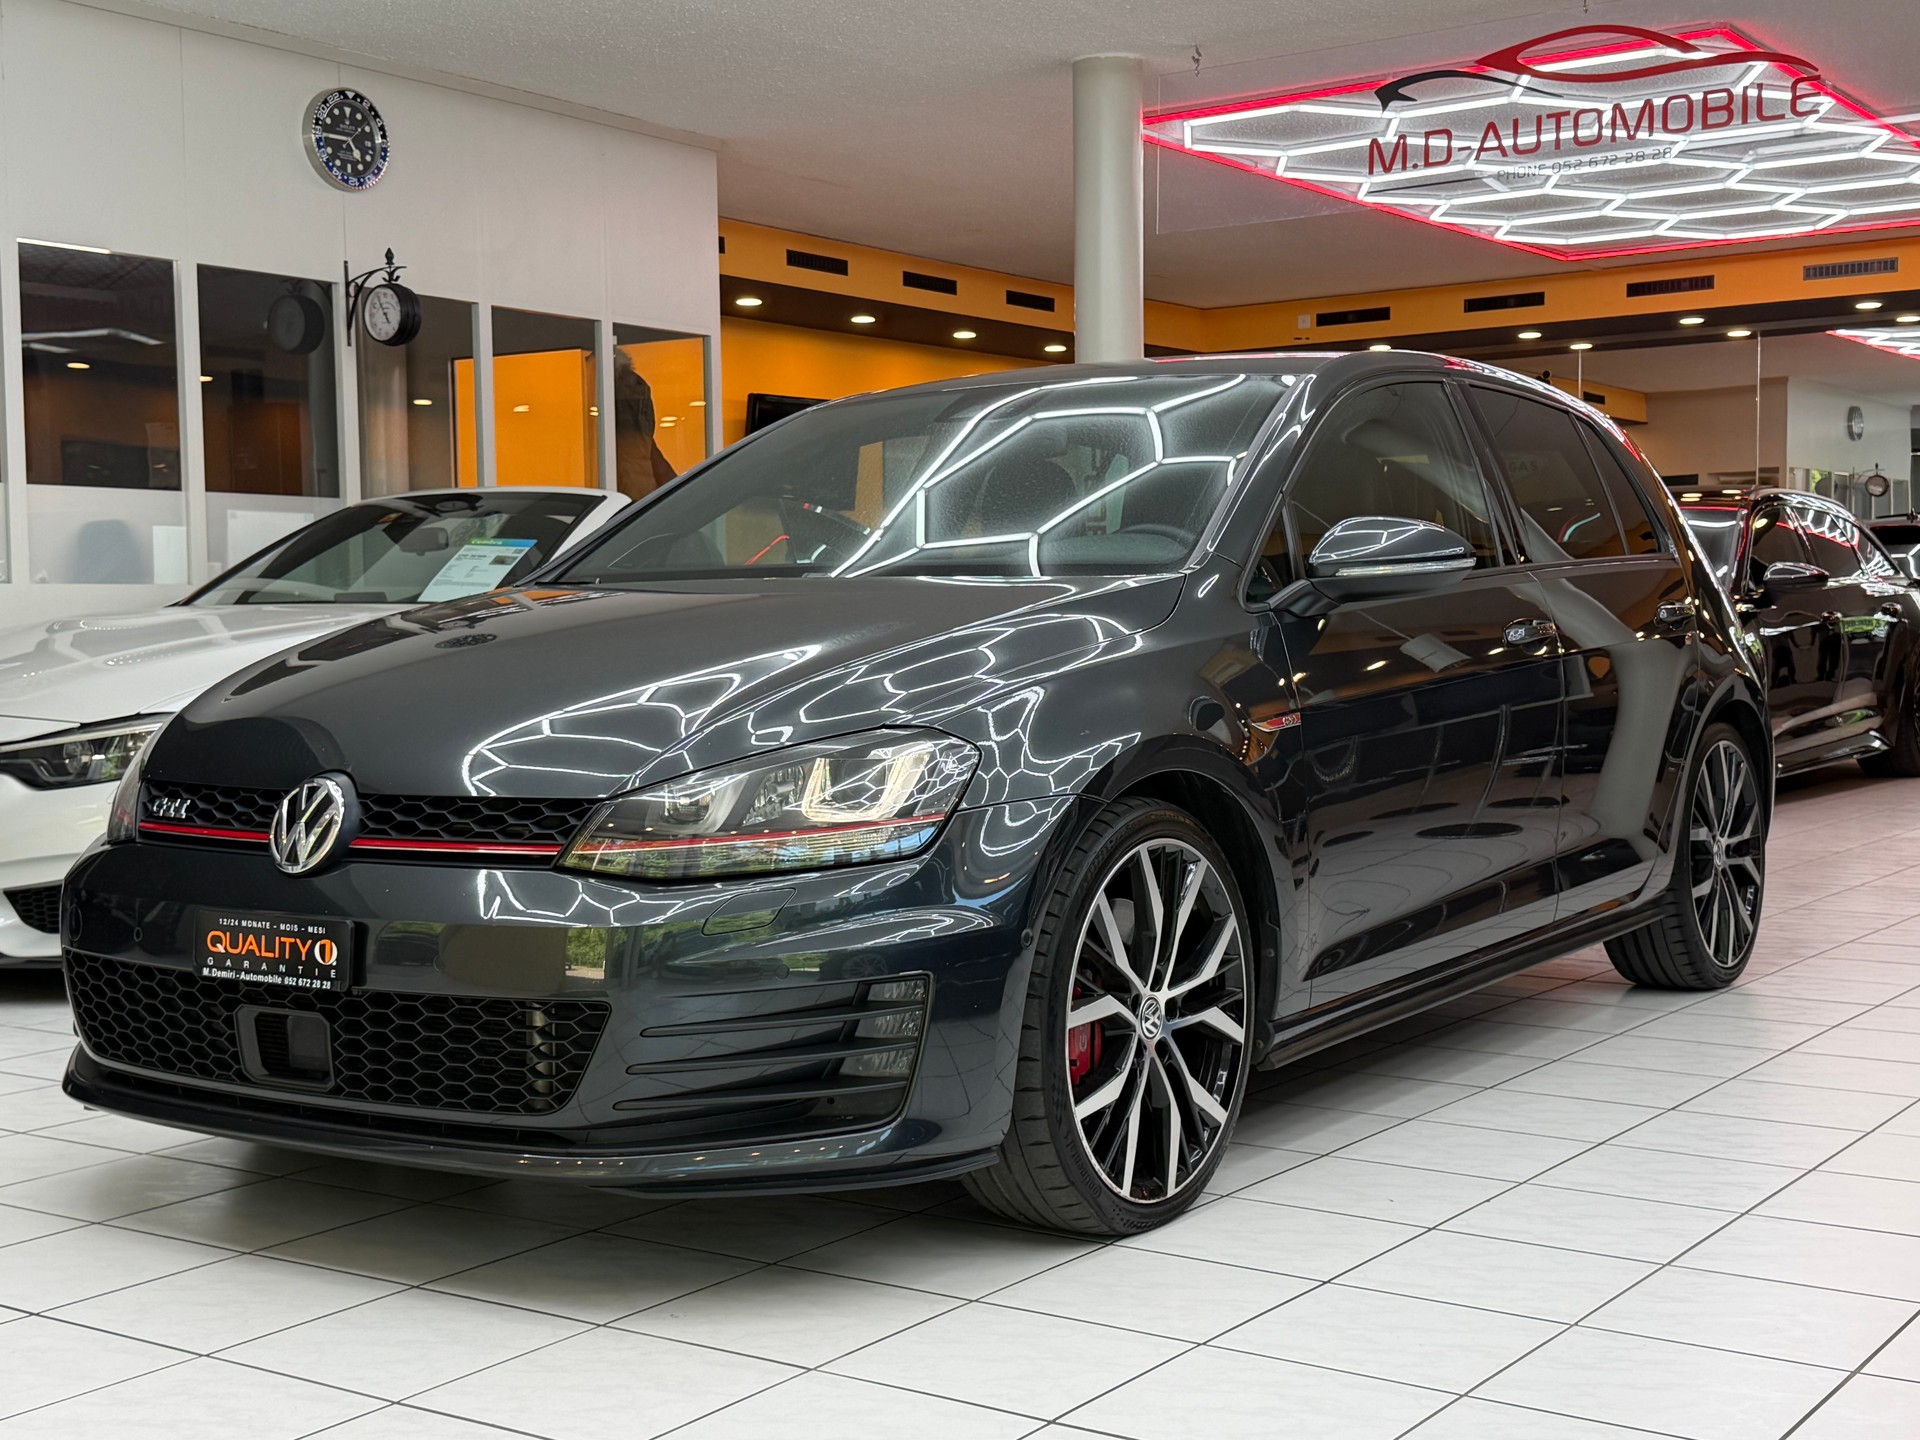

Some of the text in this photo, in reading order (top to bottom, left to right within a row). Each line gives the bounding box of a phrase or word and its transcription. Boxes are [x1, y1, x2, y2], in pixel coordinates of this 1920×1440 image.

[1497, 147, 1673, 181] PHONE 052 672 28 28
[219, 918, 239, 926] 12/24
[241, 920, 271, 929] MONATE
[280, 923, 299, 932] MOIS
[307, 925, 326, 934] MESI
[207, 930, 312, 961] QUALITY
[284, 976, 297, 986] 052
[298, 977, 311, 987] 672
[312, 979, 321, 989] 28
[322, 980, 331, 990] 28
